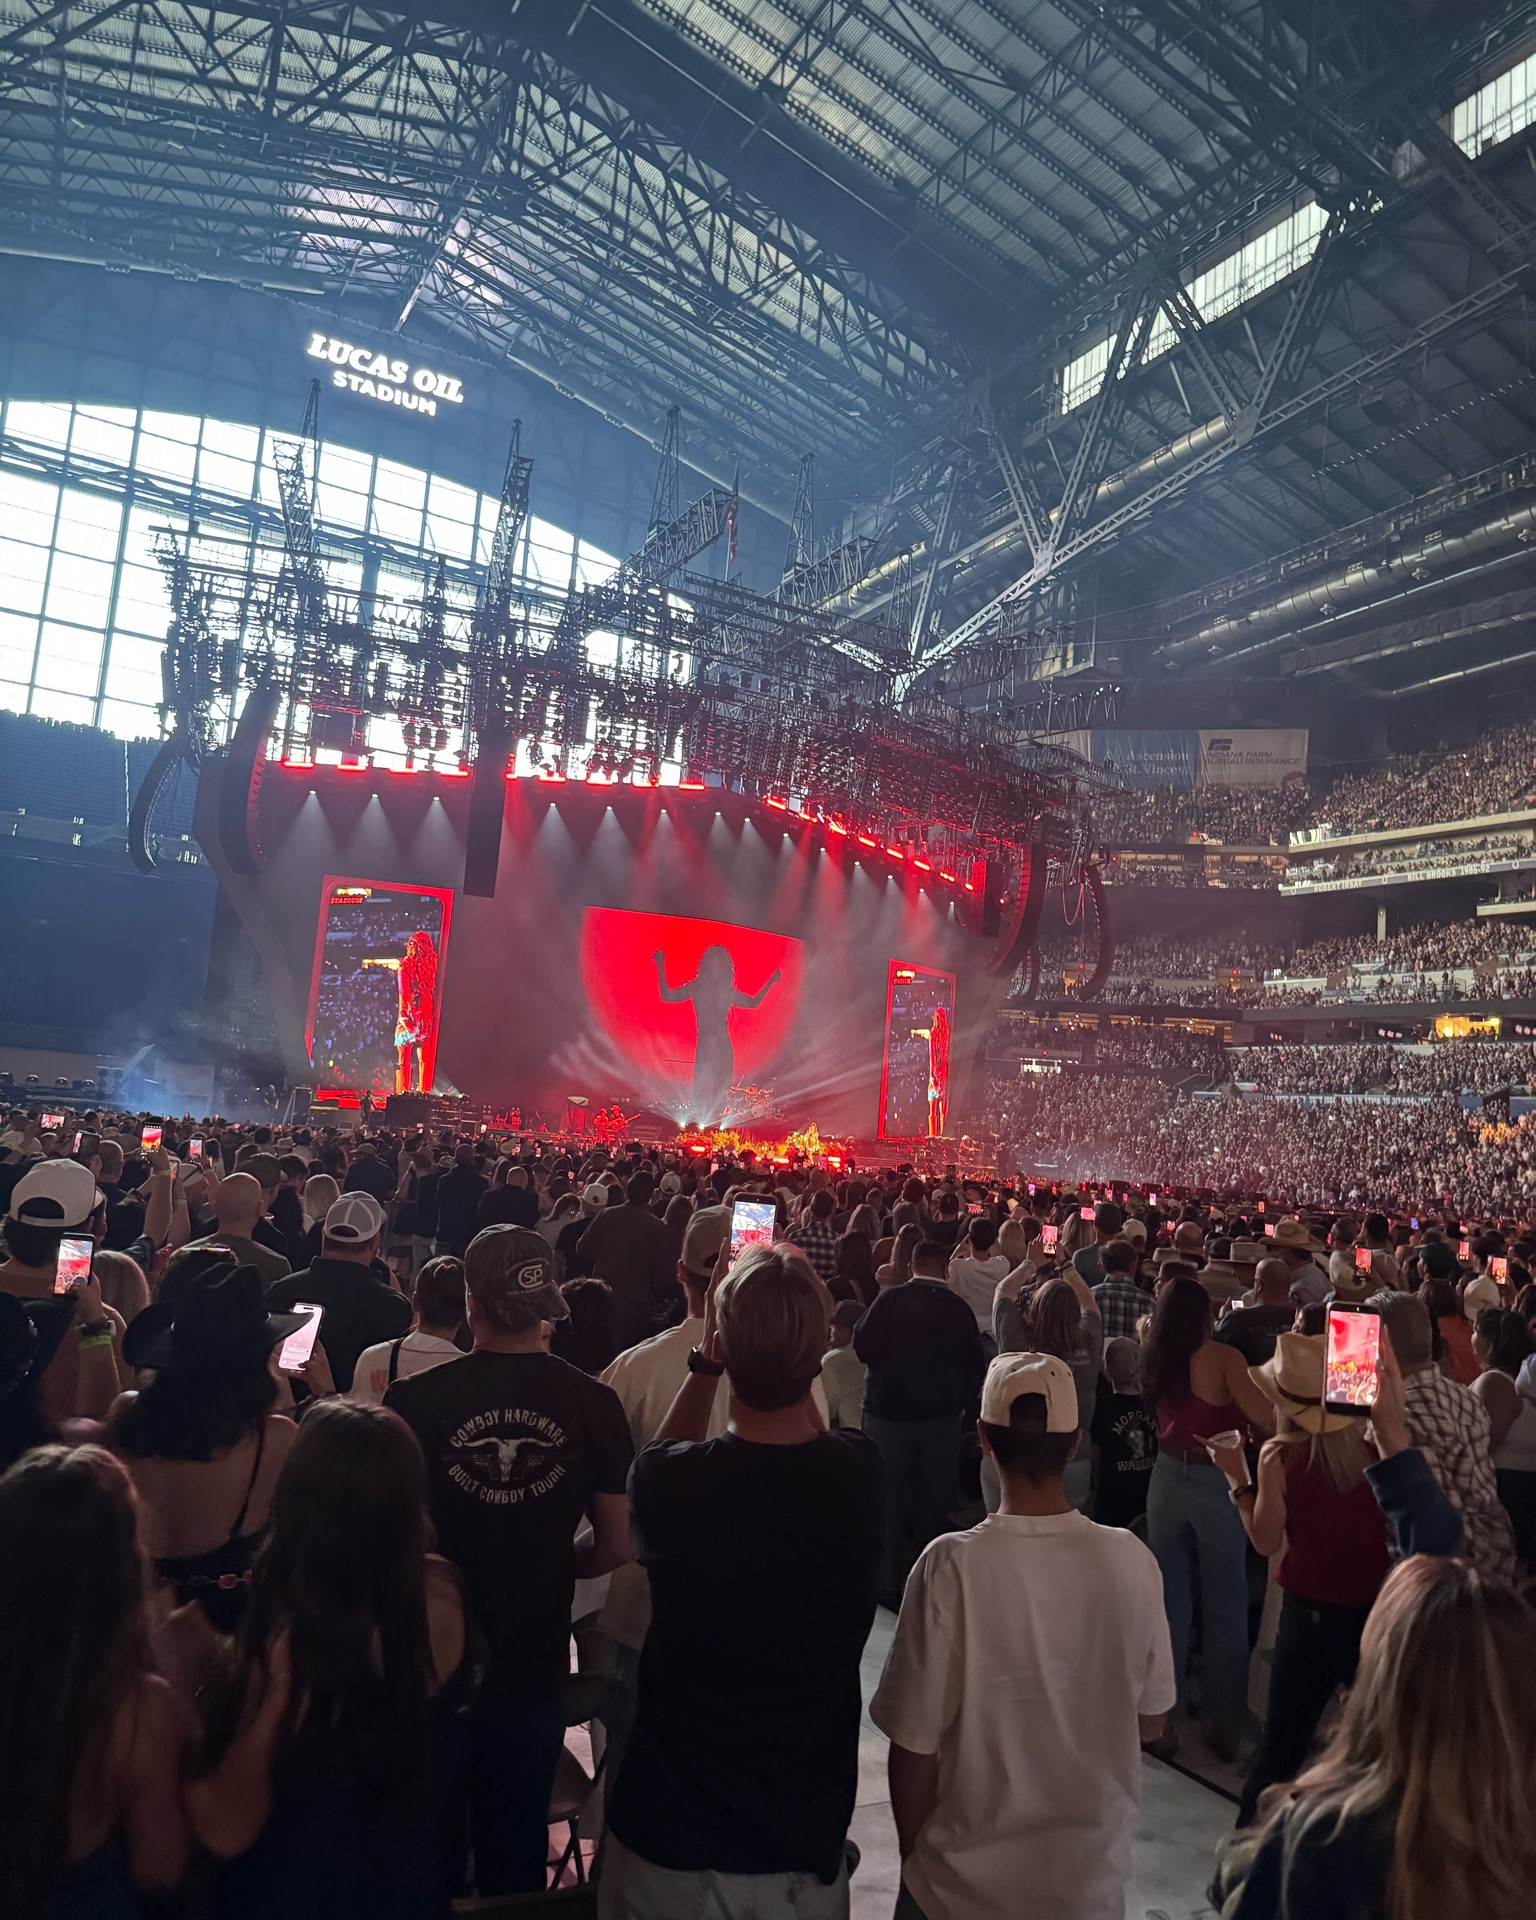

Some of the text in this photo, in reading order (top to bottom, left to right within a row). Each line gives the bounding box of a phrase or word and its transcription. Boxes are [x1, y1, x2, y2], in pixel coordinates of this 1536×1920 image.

[307, 333, 464, 404] LUCAS OIL
[333, 370, 437, 417] STADIUM
[1126, 750, 1189, 761] Ascension
[1313, 879, 1363, 893] ROBERT IRSAY
[1407, 871, 1425, 882] BILL
[1426, 866, 1456, 880] BROOKS
[330, 897, 364, 905] STADIUM
[450, 1408, 568, 1448] COWBOY HARDWARE
[448, 1463, 566, 1504] BUILT COWBOY TOUGH
